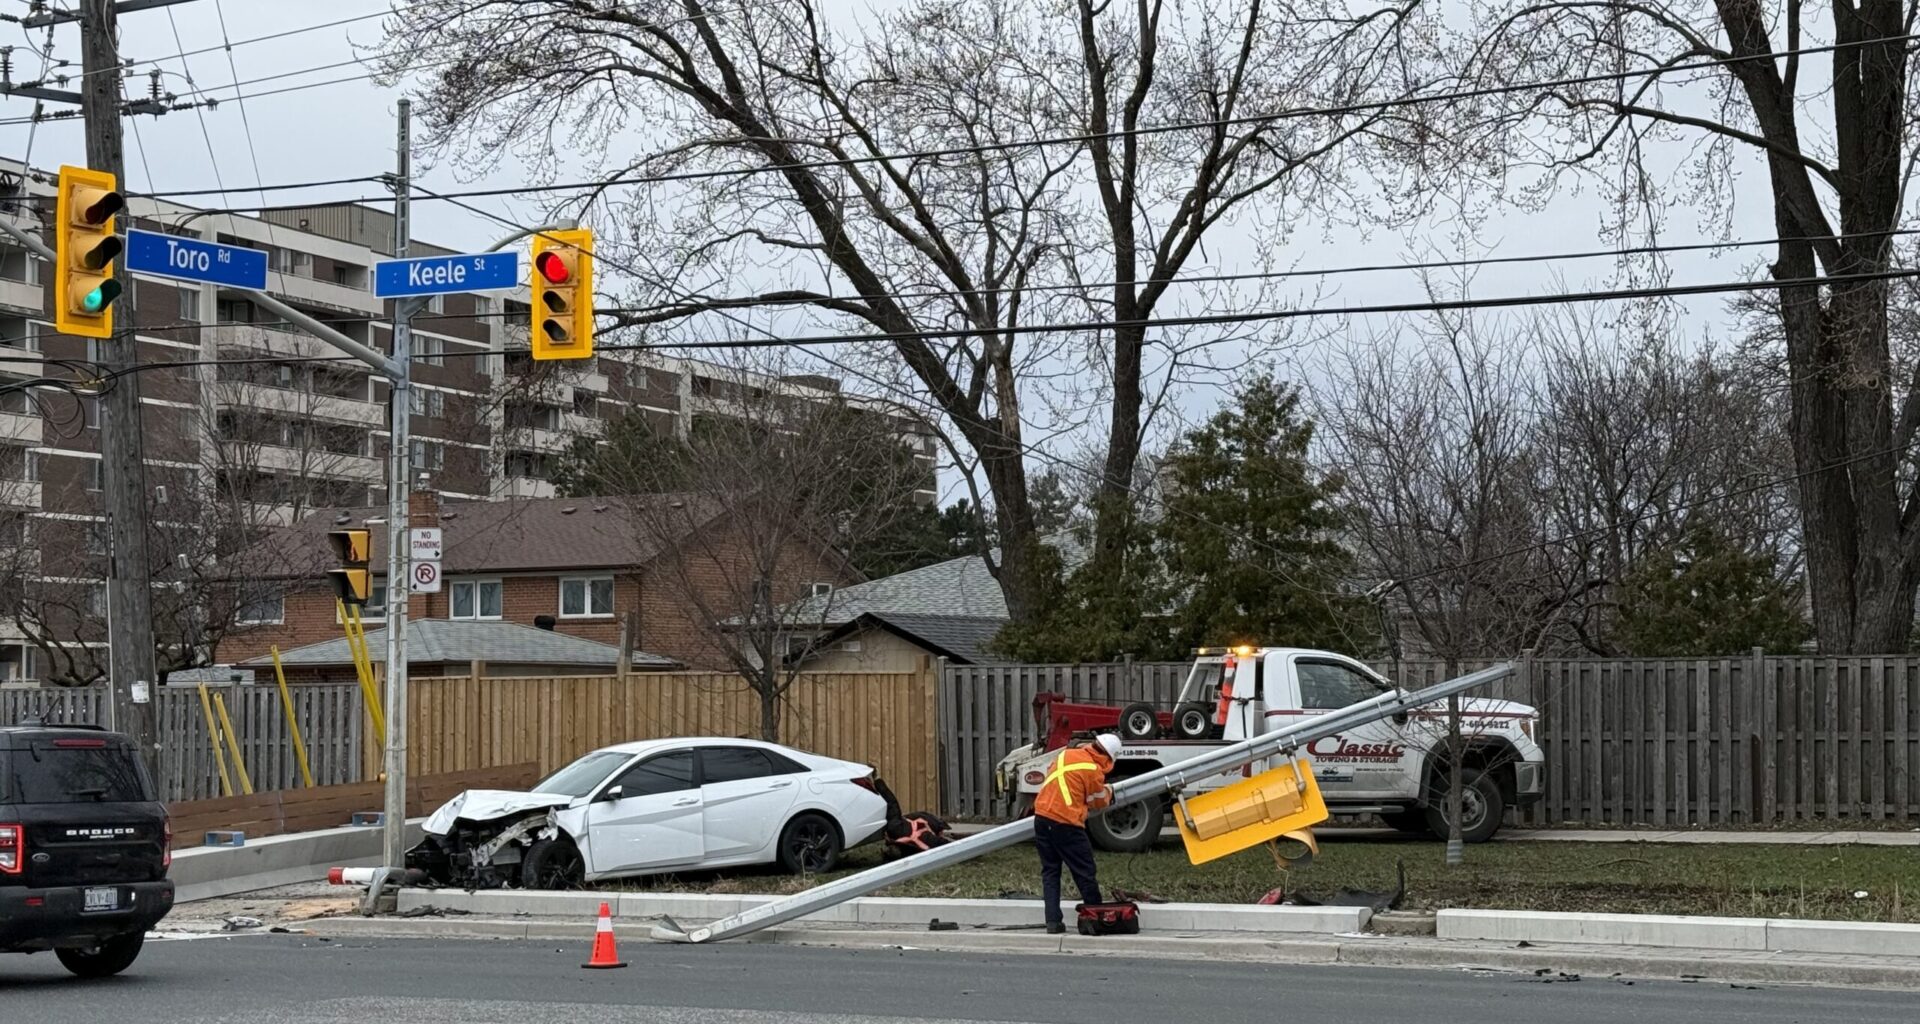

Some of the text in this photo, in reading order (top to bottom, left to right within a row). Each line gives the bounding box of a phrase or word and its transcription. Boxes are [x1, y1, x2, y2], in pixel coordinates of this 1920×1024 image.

[167, 240, 231, 272] Toro Rd
[409, 258, 485, 286] Keele St
[421, 531, 431, 539] NO
[413, 541, 440, 549] STANDING
[1306, 734, 1407, 757] Classic
[66, 828, 134, 836] BRONCO
